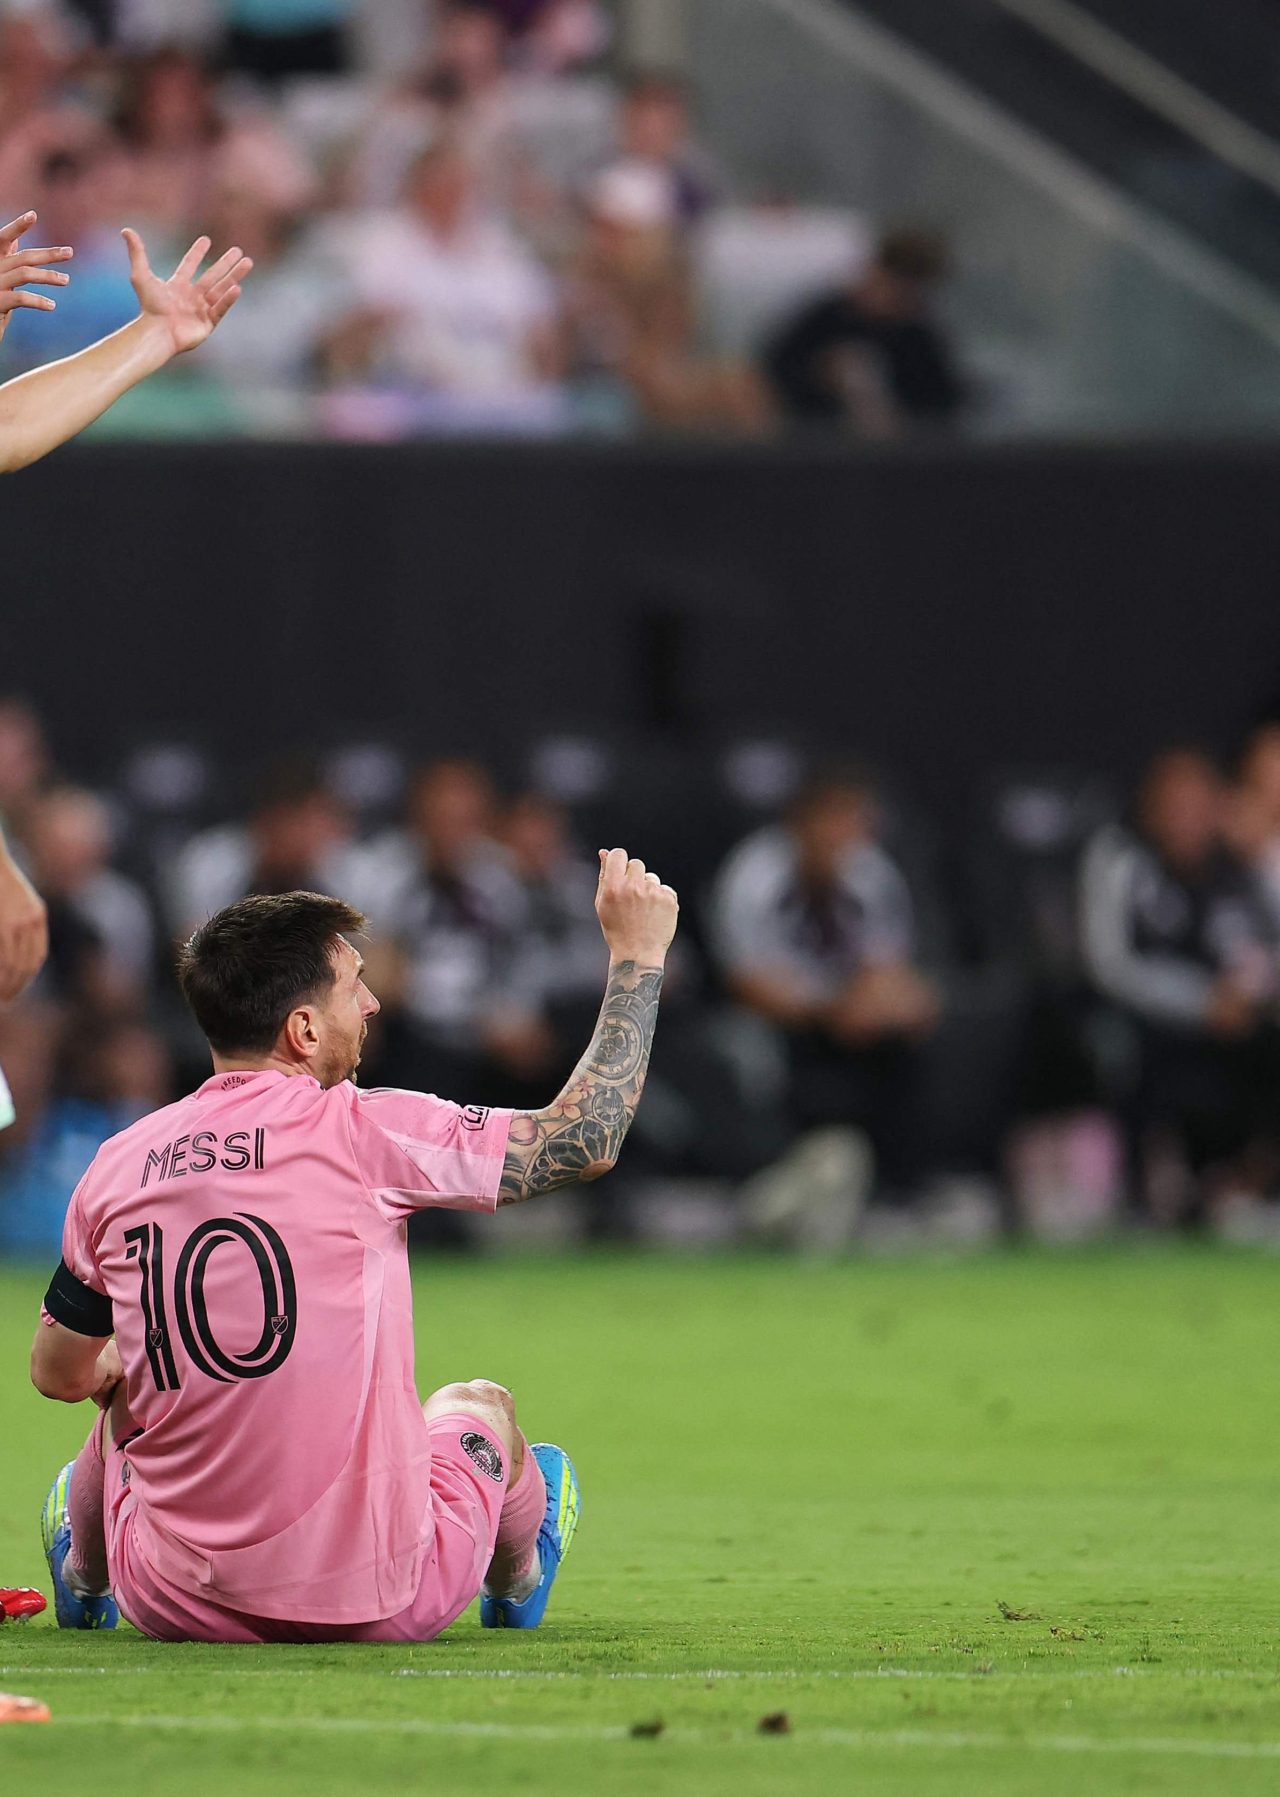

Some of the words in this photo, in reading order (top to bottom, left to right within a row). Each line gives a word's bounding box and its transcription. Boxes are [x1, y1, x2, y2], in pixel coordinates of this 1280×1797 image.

[220, 1076, 247, 1091] FREEDO
[140, 1128, 265, 1189] MESSI
[123, 1212, 297, 1392] 10
